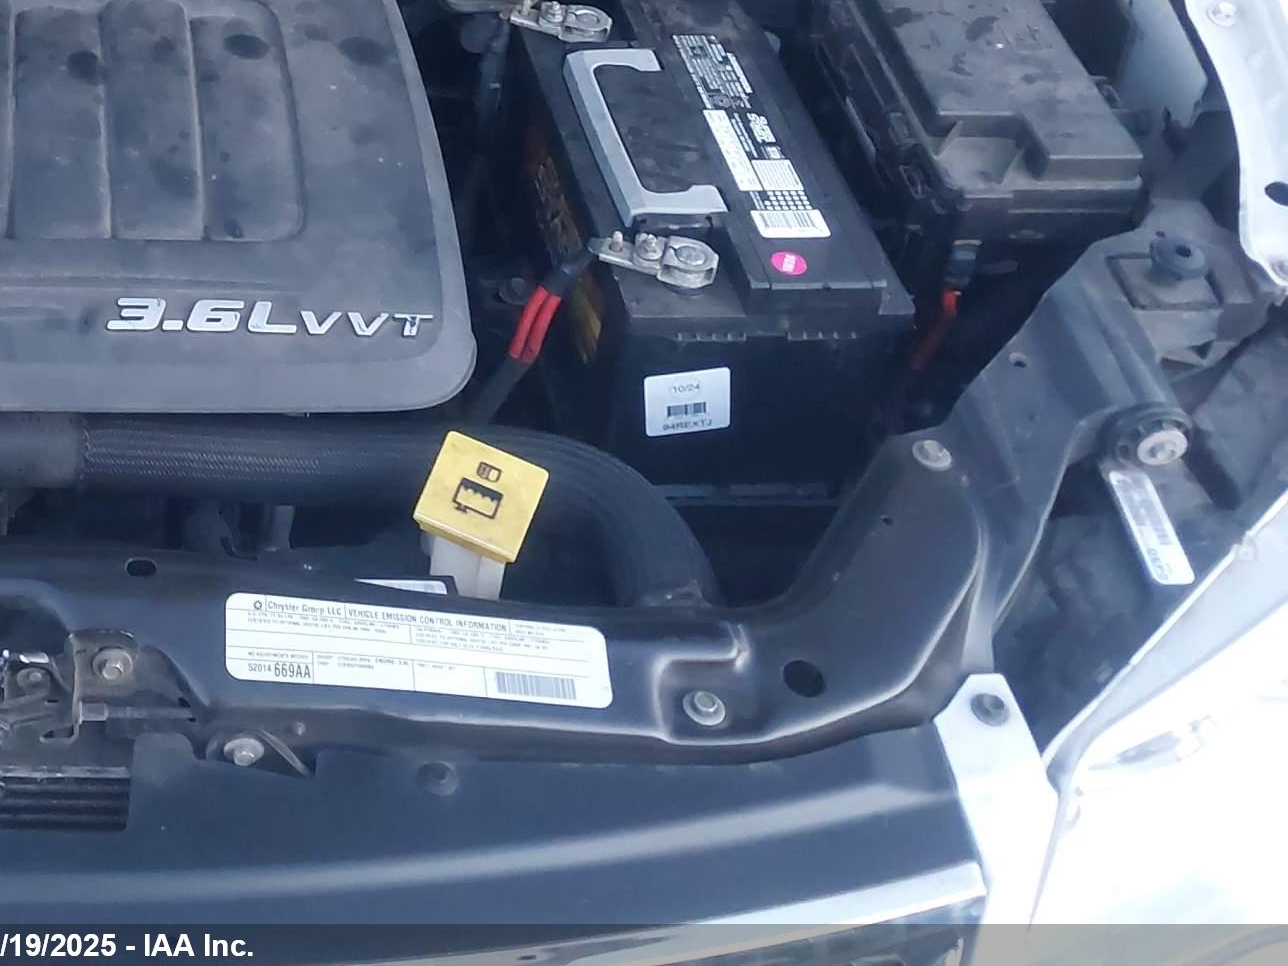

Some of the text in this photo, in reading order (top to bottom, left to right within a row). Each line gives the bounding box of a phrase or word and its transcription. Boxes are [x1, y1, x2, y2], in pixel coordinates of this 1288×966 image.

[107, 297, 434, 336] 3.6L VVT
[267, 600, 342, 616] Chrysler Group LLC
[348, 608, 379, 620] VEHICLE
[381, 611, 417, 623] EMISSION
[419, 615, 453, 627] CONTROL
[455, 619, 507, 632] INFORMATION
[247, 662, 272, 673] 52014
[274, 662, 312, 680] 669AA
